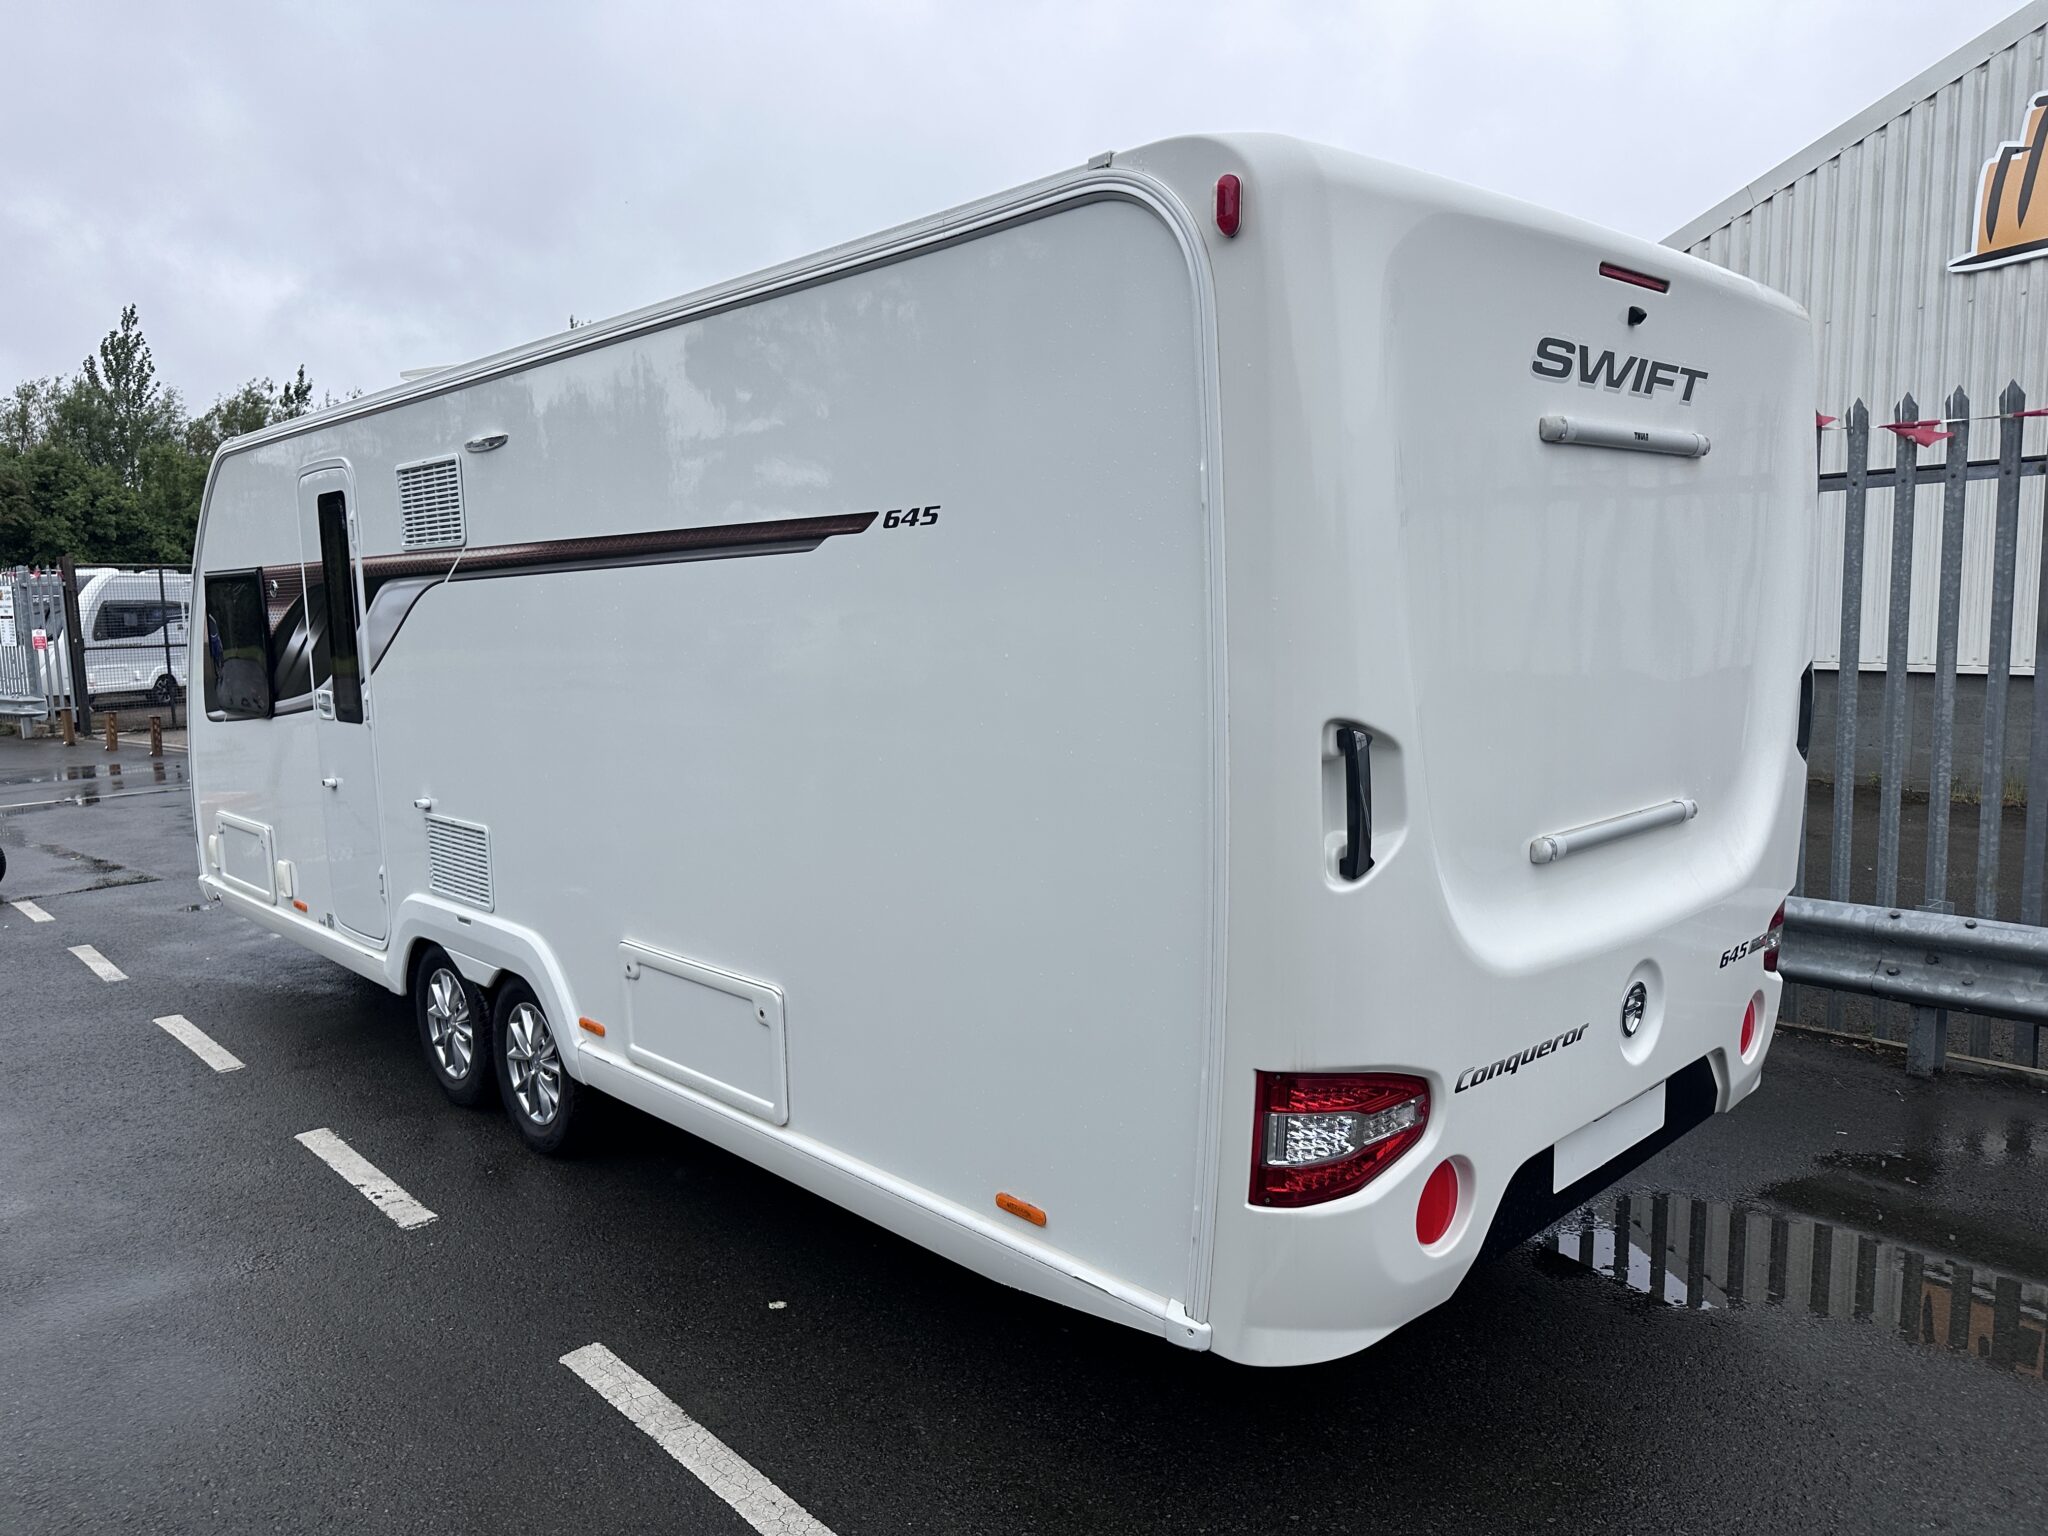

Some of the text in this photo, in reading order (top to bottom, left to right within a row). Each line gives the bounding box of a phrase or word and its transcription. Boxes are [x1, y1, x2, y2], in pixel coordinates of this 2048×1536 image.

[1532, 336, 1709, 403] SWIFT
[882, 504, 941, 529] 645
[1719, 940, 1749, 969] 645
[1454, 1022, 1590, 1094] Conqueror
